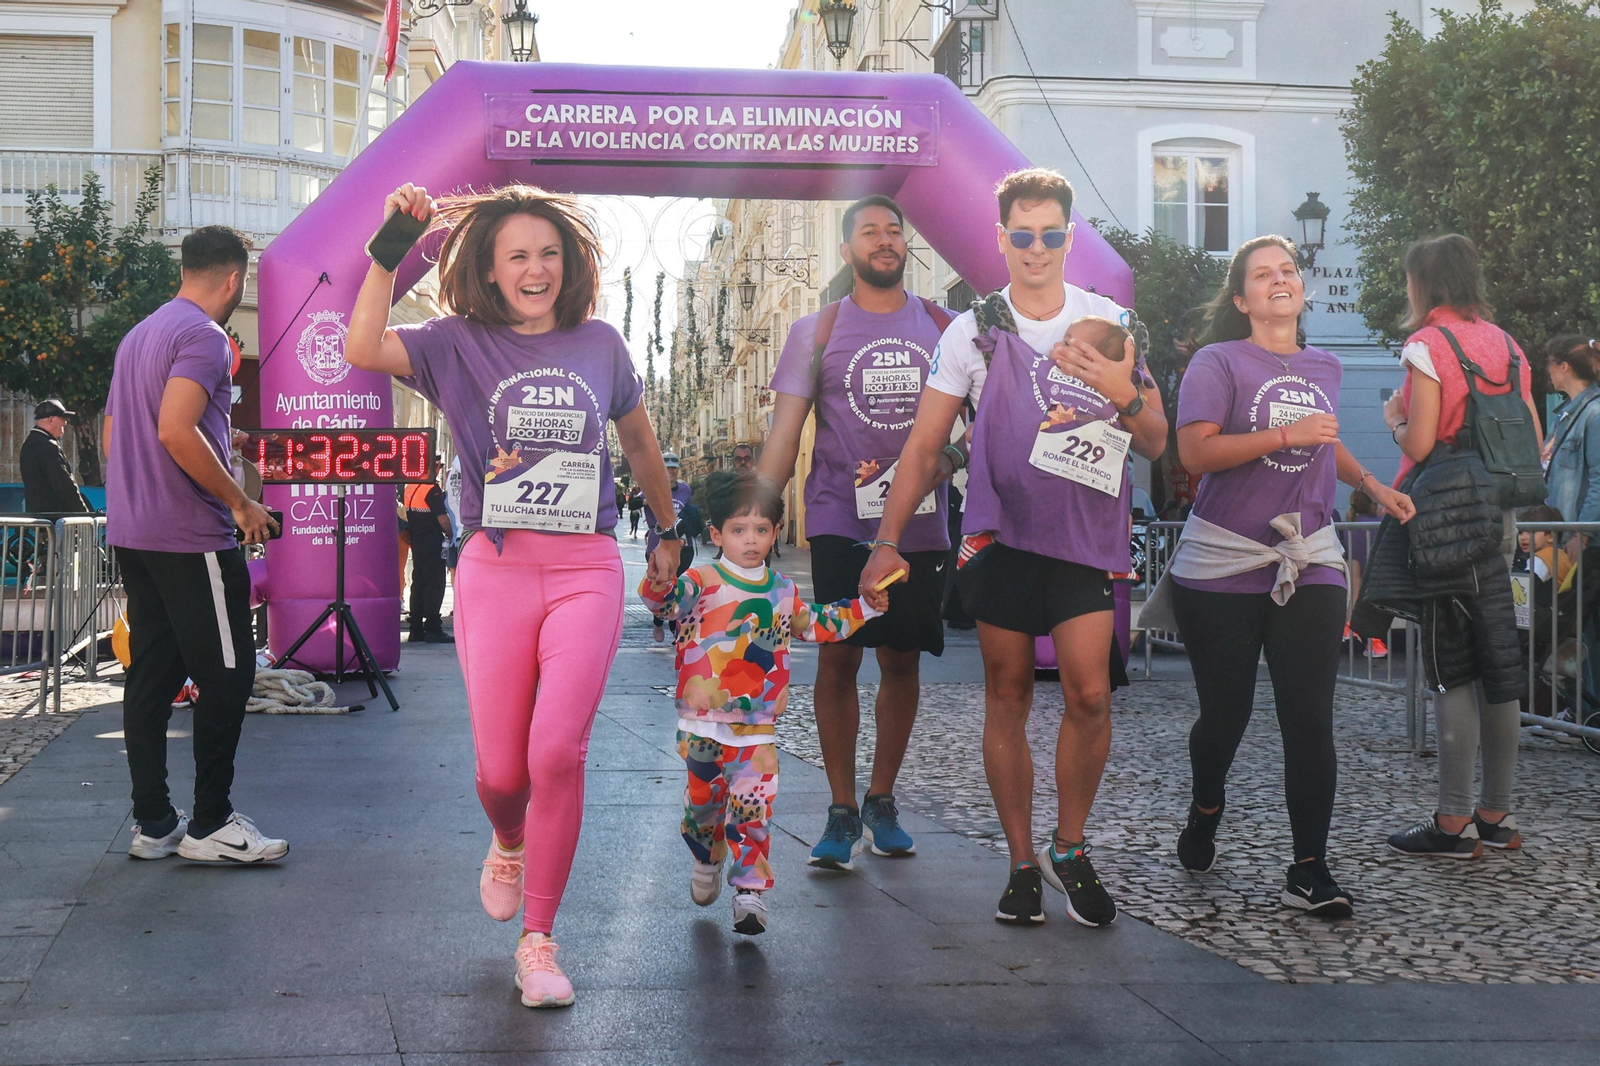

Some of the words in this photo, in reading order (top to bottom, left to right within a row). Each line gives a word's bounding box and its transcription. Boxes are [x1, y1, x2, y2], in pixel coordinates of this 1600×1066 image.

[524, 104, 637, 125] CARRERA
[648, 106, 699, 126] POR
[706, 107, 736, 126] LA
[742, 105, 902, 128] ELIMINACIÓN
[505, 130, 534, 148] DE
[538, 130, 564, 148] LA
[569, 130, 684, 150] VIOLENCIA
[694, 132, 782, 151] CONTRA
[787, 134, 824, 152] LAS
[828, 134, 920, 154] MUJERES
[1312, 266, 1364, 278] PLAZA
[1328, 284, 1348, 296] DE
[847, 338, 903, 372] INTERNACIONAL
[872, 351, 910, 366] 25N
[904, 340, 932, 366] CONTRA
[490, 368, 566, 405] INTERNACIONAL
[843, 374, 852, 388] DÍA
[865, 384, 883, 392] 900
[895, 383, 904, 391] 21
[906, 382, 917, 390] 30
[882, 374, 911, 382] HORAS
[521, 385, 574, 406] 25N
[568, 372, 600, 410] CONTRA
[1248, 405, 1258, 422] DÍA
[1253, 375, 1307, 404] INTERNACIONAL
[1277, 388, 1316, 406] 25N
[276, 390, 381, 416] Ayuntamiento
[847, 391, 872, 424] MUJERES
[292, 416, 312, 429] de
[317, 414, 367, 429] Cádiz
[487, 405, 495, 424] DÍA
[519, 417, 532, 427] 24
[534, 418, 573, 428] HORAS
[1279, 410, 1288, 418] 24
[872, 420, 888, 430] LAS
[890, 418, 914, 430] HACIA
[510, 428, 535, 437] 900
[537, 430, 547, 439] 21
[550, 430, 560, 438] 21
[563, 430, 578, 440] 30
[258, 435, 426, 478] 11:32:20
[1061, 435, 1105, 464] 229
[561, 461, 595, 469] CARRERA
[1042, 450, 1072, 465] ROMPE
[1072, 460, 1079, 468] EL
[1080, 464, 1112, 480] SILENCIO
[515, 480, 570, 506] 227
[290, 495, 375, 521] CÁDIZ
[490, 504, 502, 512] TU
[504, 505, 535, 515] LUCHA
[536, 508, 546, 516] ES
[548, 509, 559, 517] MI
[561, 510, 592, 519] LUCHA
[292, 524, 334, 535] Fundación
[336, 524, 375, 534] unicipal
[312, 536, 323, 545] de
[325, 536, 333, 545] la
[335, 536, 359, 546] ujer
